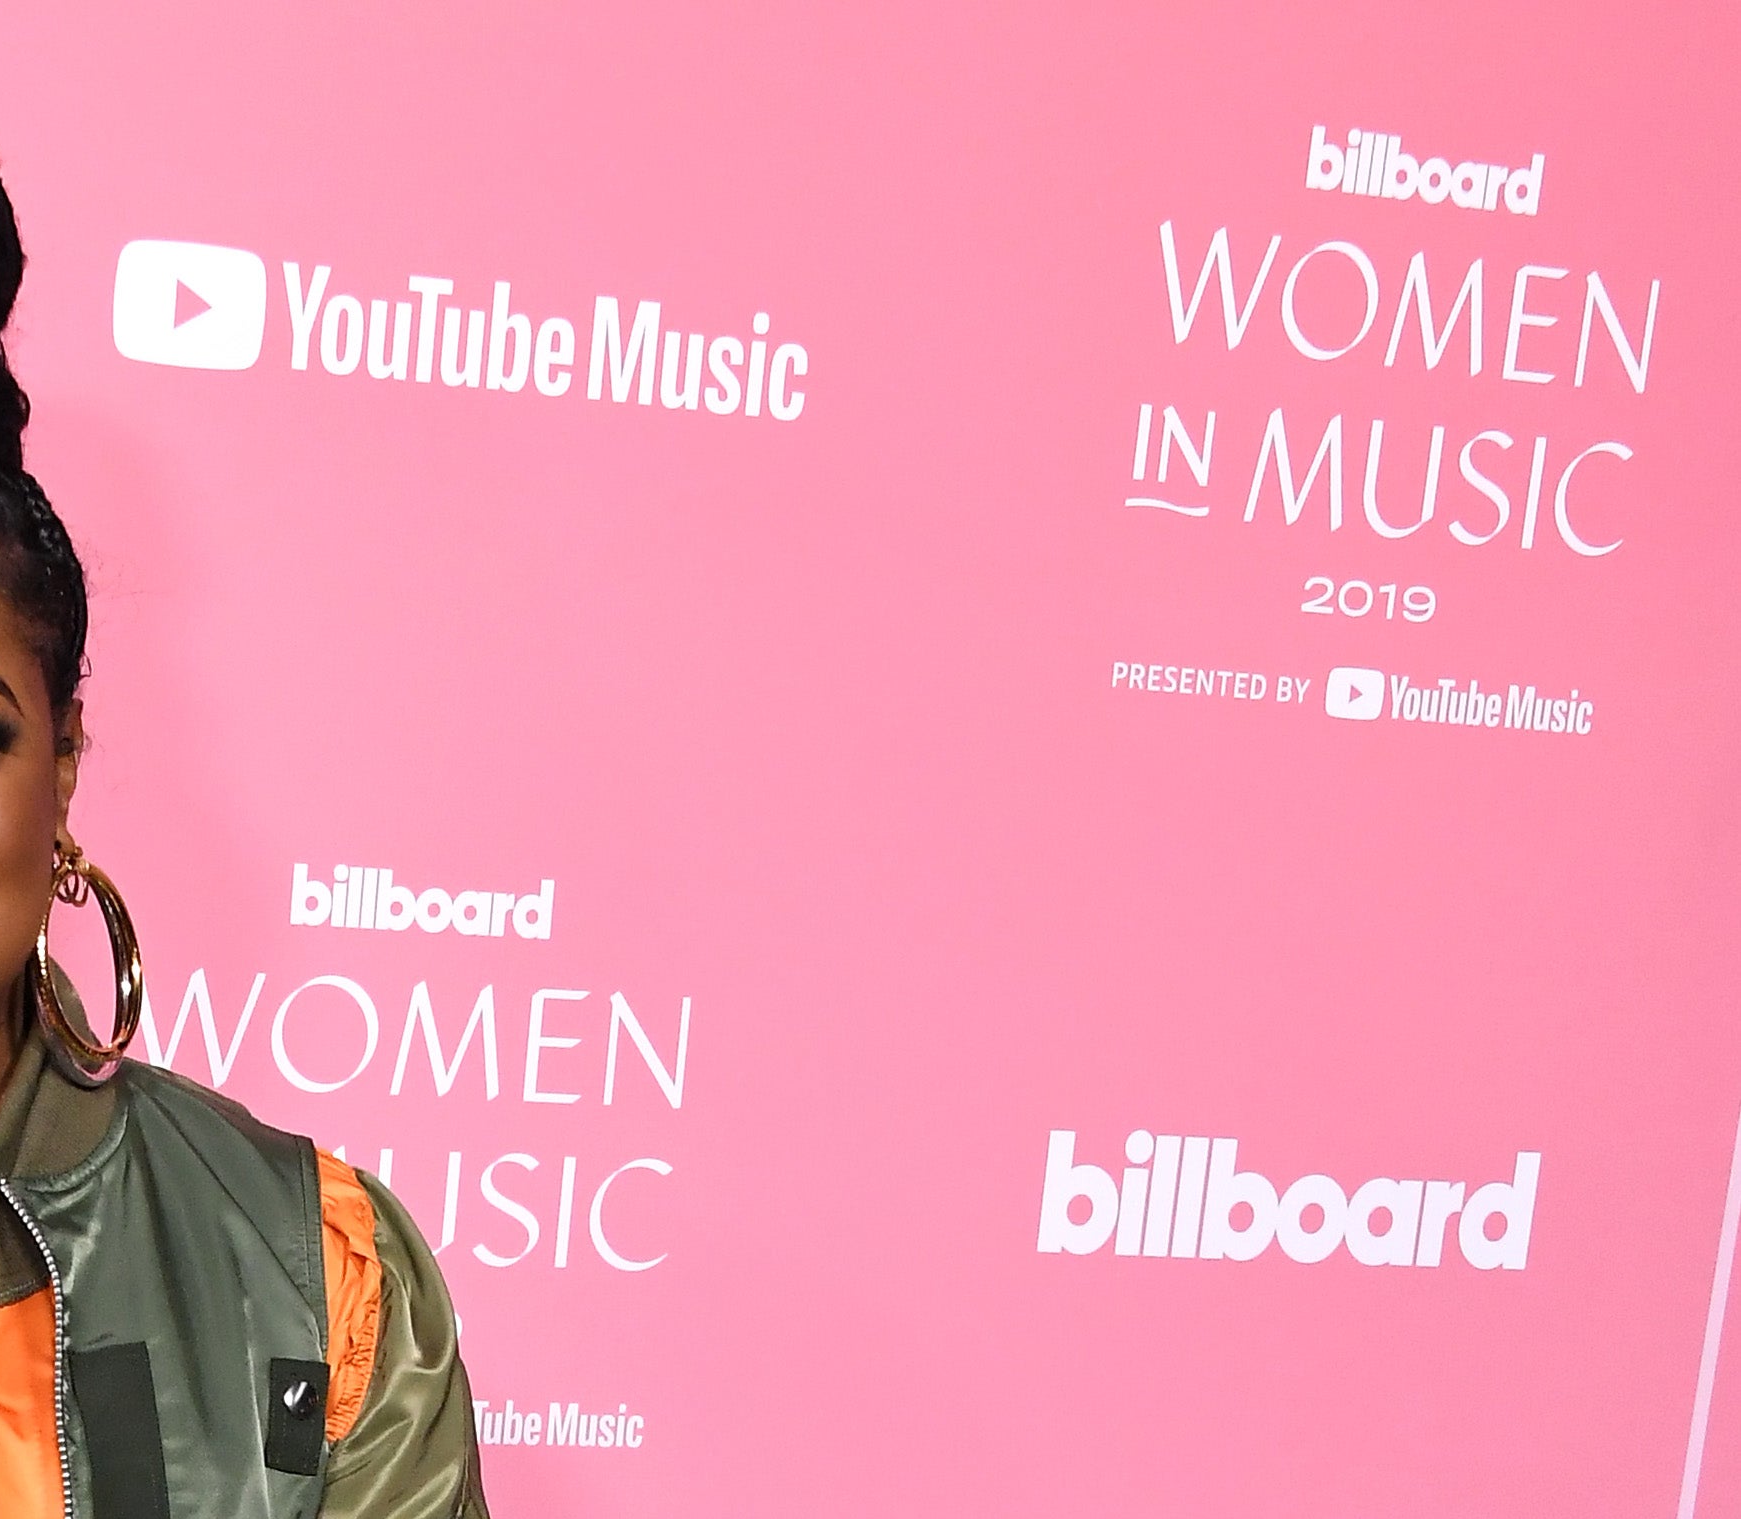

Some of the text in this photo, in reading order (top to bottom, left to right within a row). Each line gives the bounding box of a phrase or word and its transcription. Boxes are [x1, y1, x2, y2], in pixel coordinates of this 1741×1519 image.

[1305, 125, 1545, 216] billboard
[282, 261, 808, 421] YouTube Music
[1159, 220, 1661, 394] WOMEN
[1132, 403, 1633, 557] IN MUSIC
[1300, 576, 1437, 623] 2019
[1111, 661, 1594, 735] PRESENTED BY YouTube Music
[289, 862, 555, 940] billboard
[140, 967, 692, 1109] WOMEN
[332, 1145, 673, 1272] USIC
[1036, 1129, 1542, 1270] billboard
[473, 1399, 644, 1448] Tube Music
